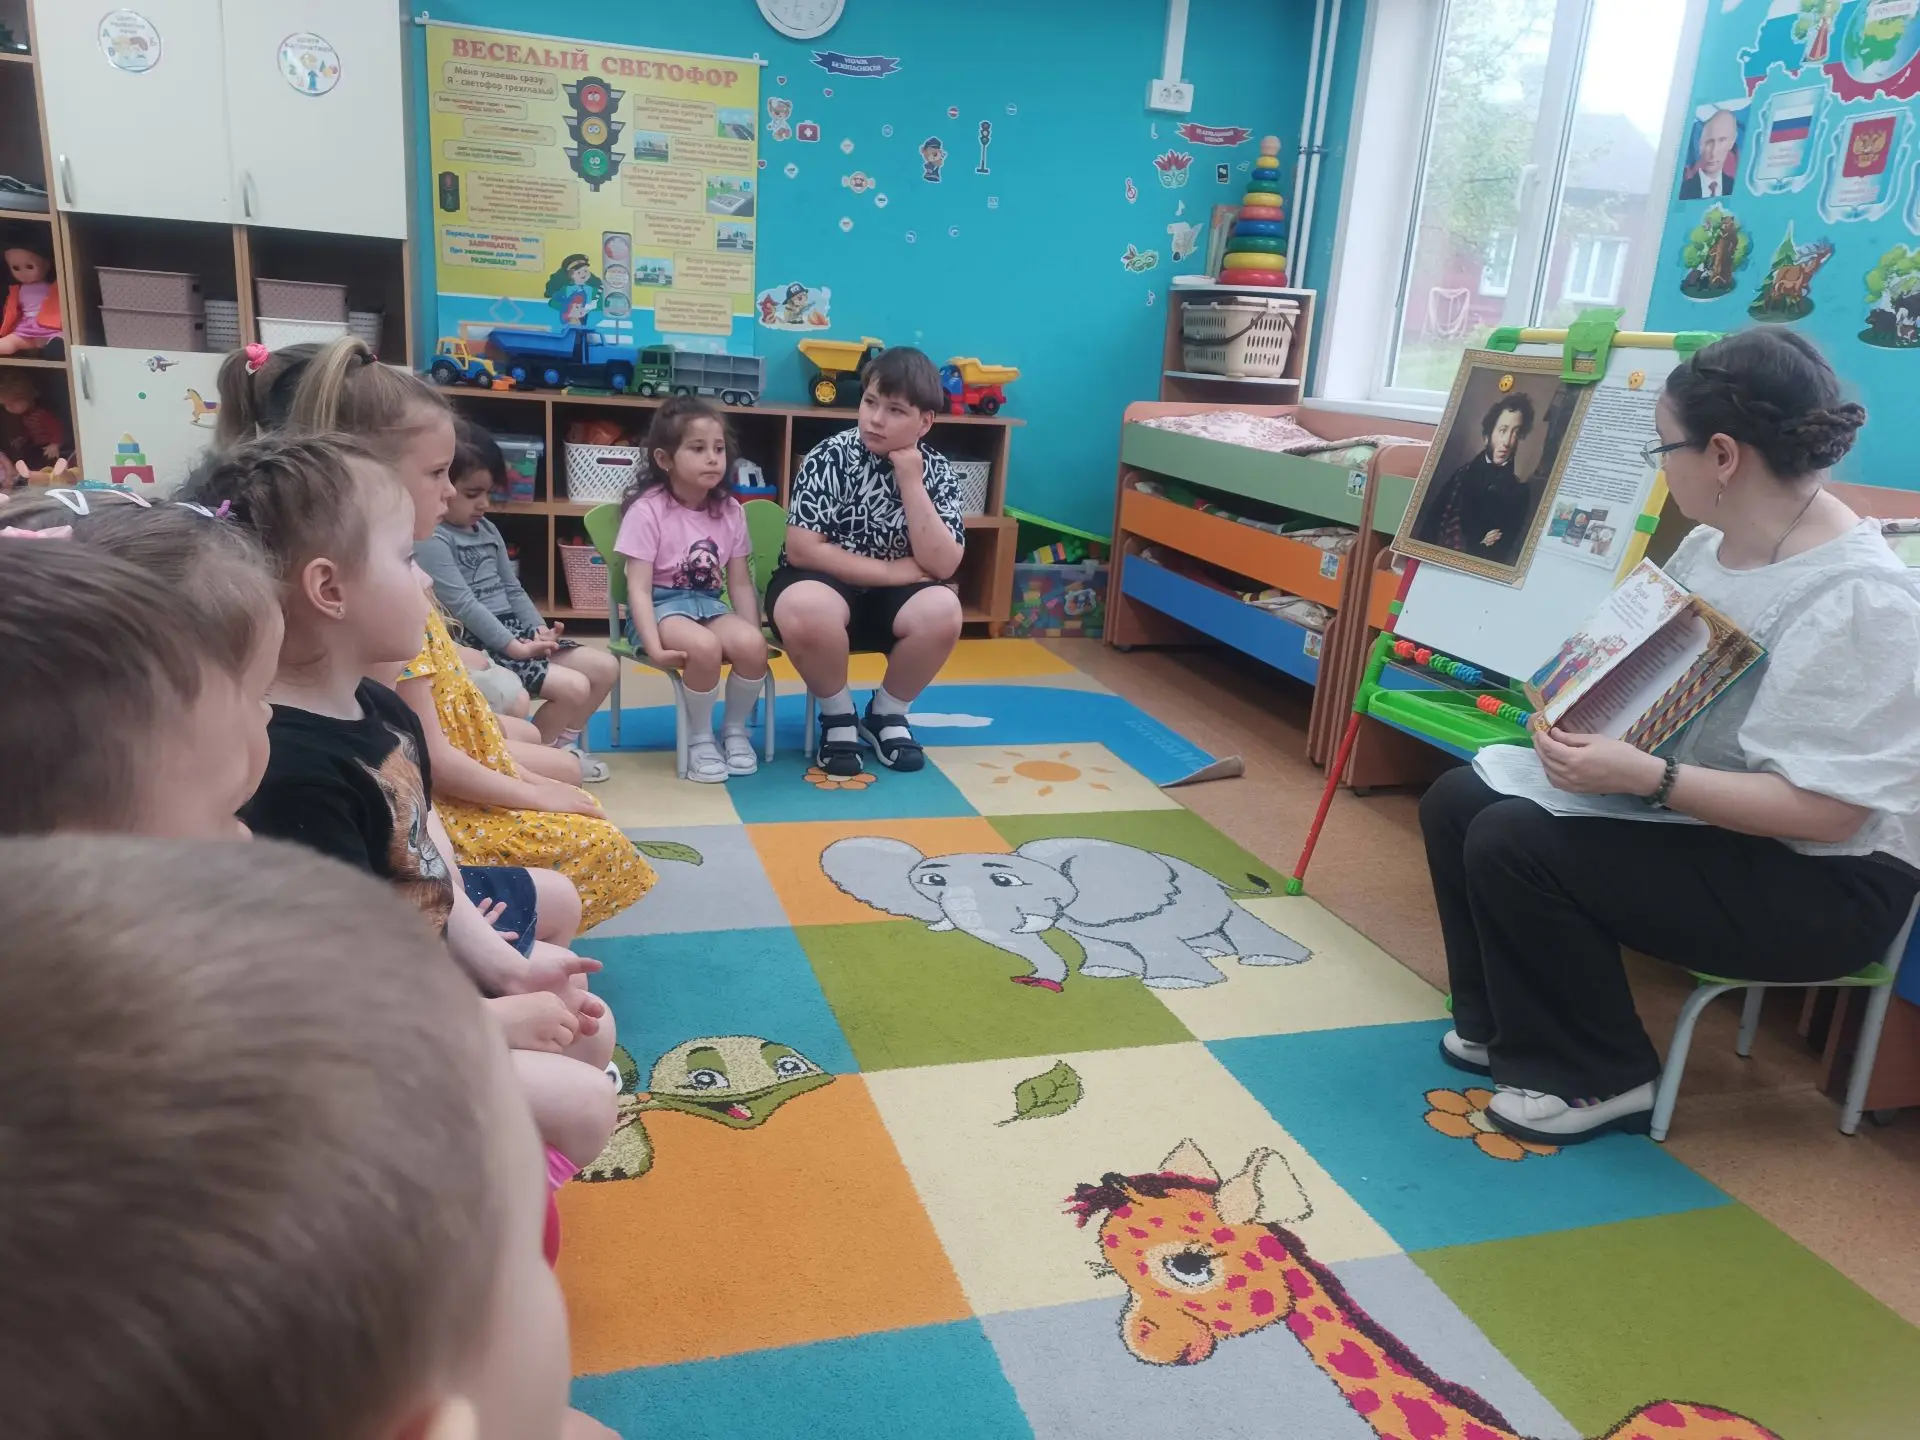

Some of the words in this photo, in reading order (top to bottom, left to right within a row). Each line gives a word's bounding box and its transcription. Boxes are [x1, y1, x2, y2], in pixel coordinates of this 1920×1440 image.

[452, 38, 589, 72] ВЕСЕЛЫЙ
[601, 57, 739, 88] СВЕТОФОР
[454, 66, 479, 76] Меня
[480, 69, 518, 82] узнаешь
[461, 79, 503, 92] светофор
